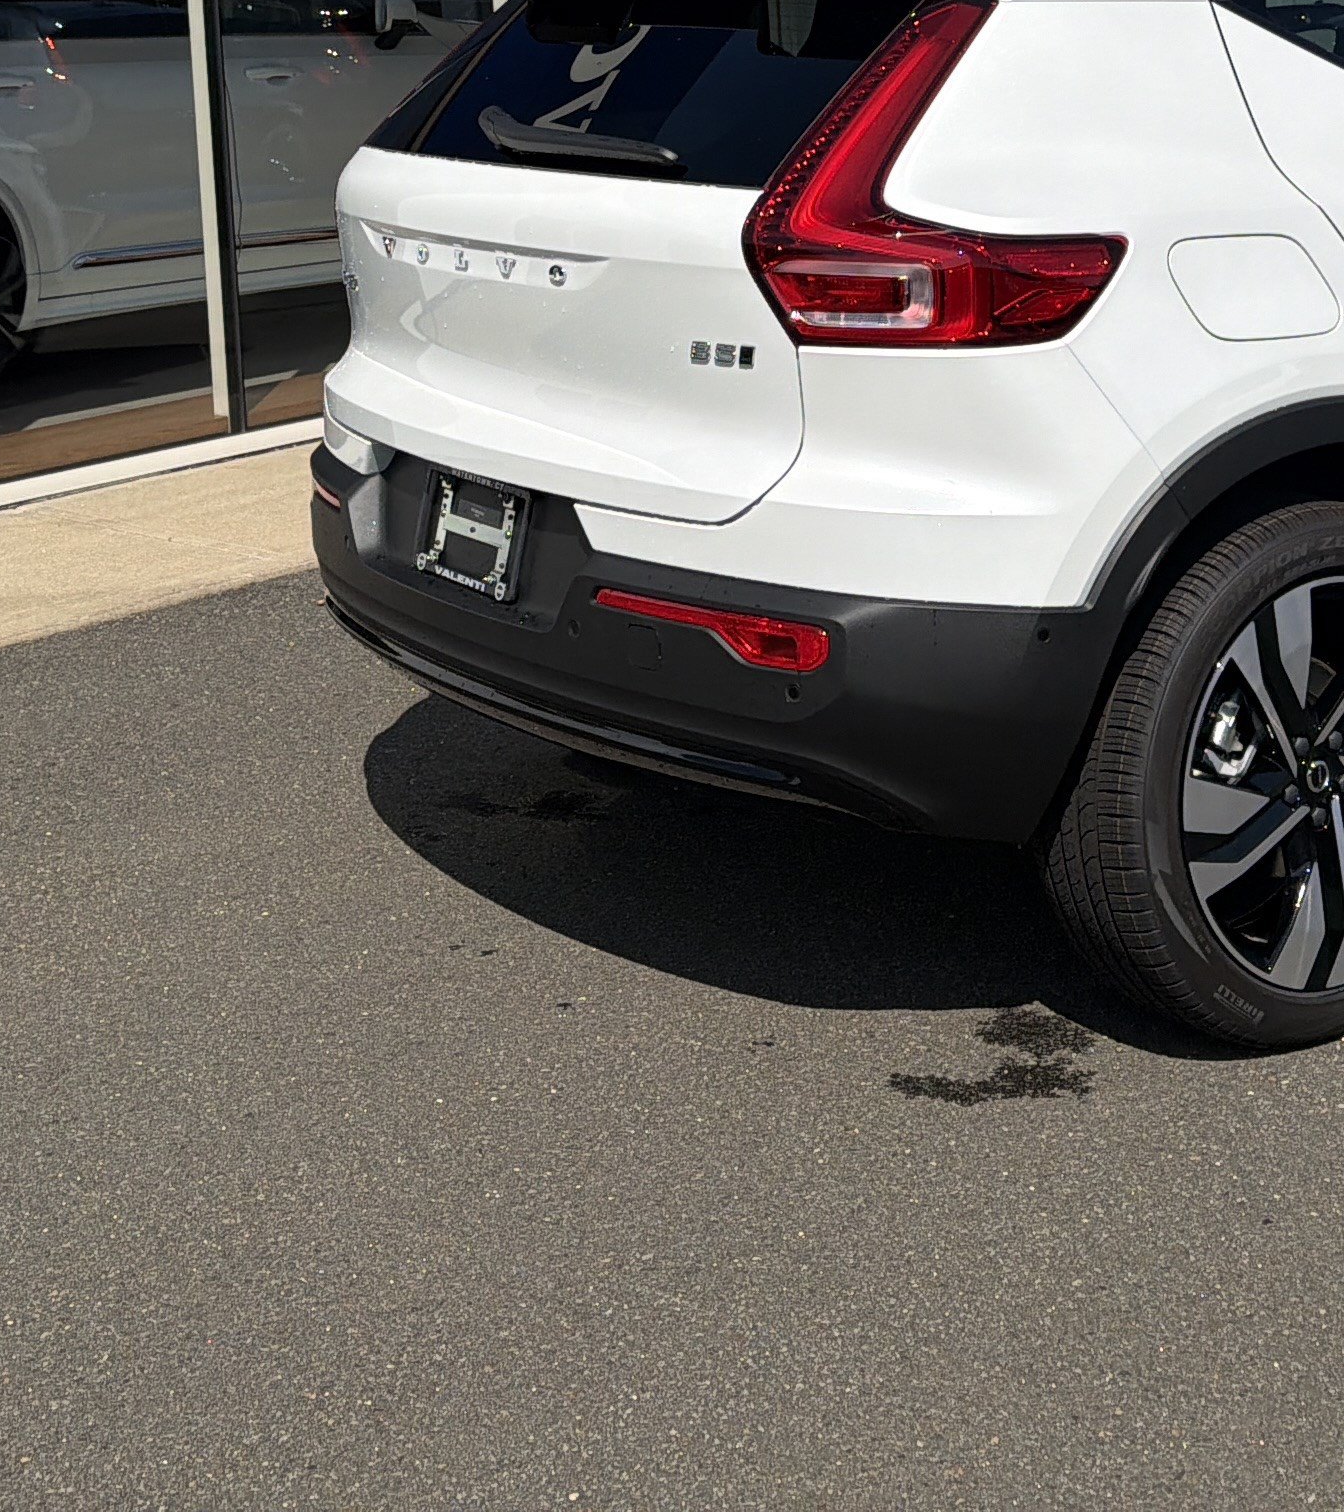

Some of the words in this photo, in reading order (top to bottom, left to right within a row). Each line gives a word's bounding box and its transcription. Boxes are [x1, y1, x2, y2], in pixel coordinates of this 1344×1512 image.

[382, 236, 567, 287] VOLVO
[434, 564, 486, 592] VALENTI
[1212, 983, 1265, 1026] PIRELLI
